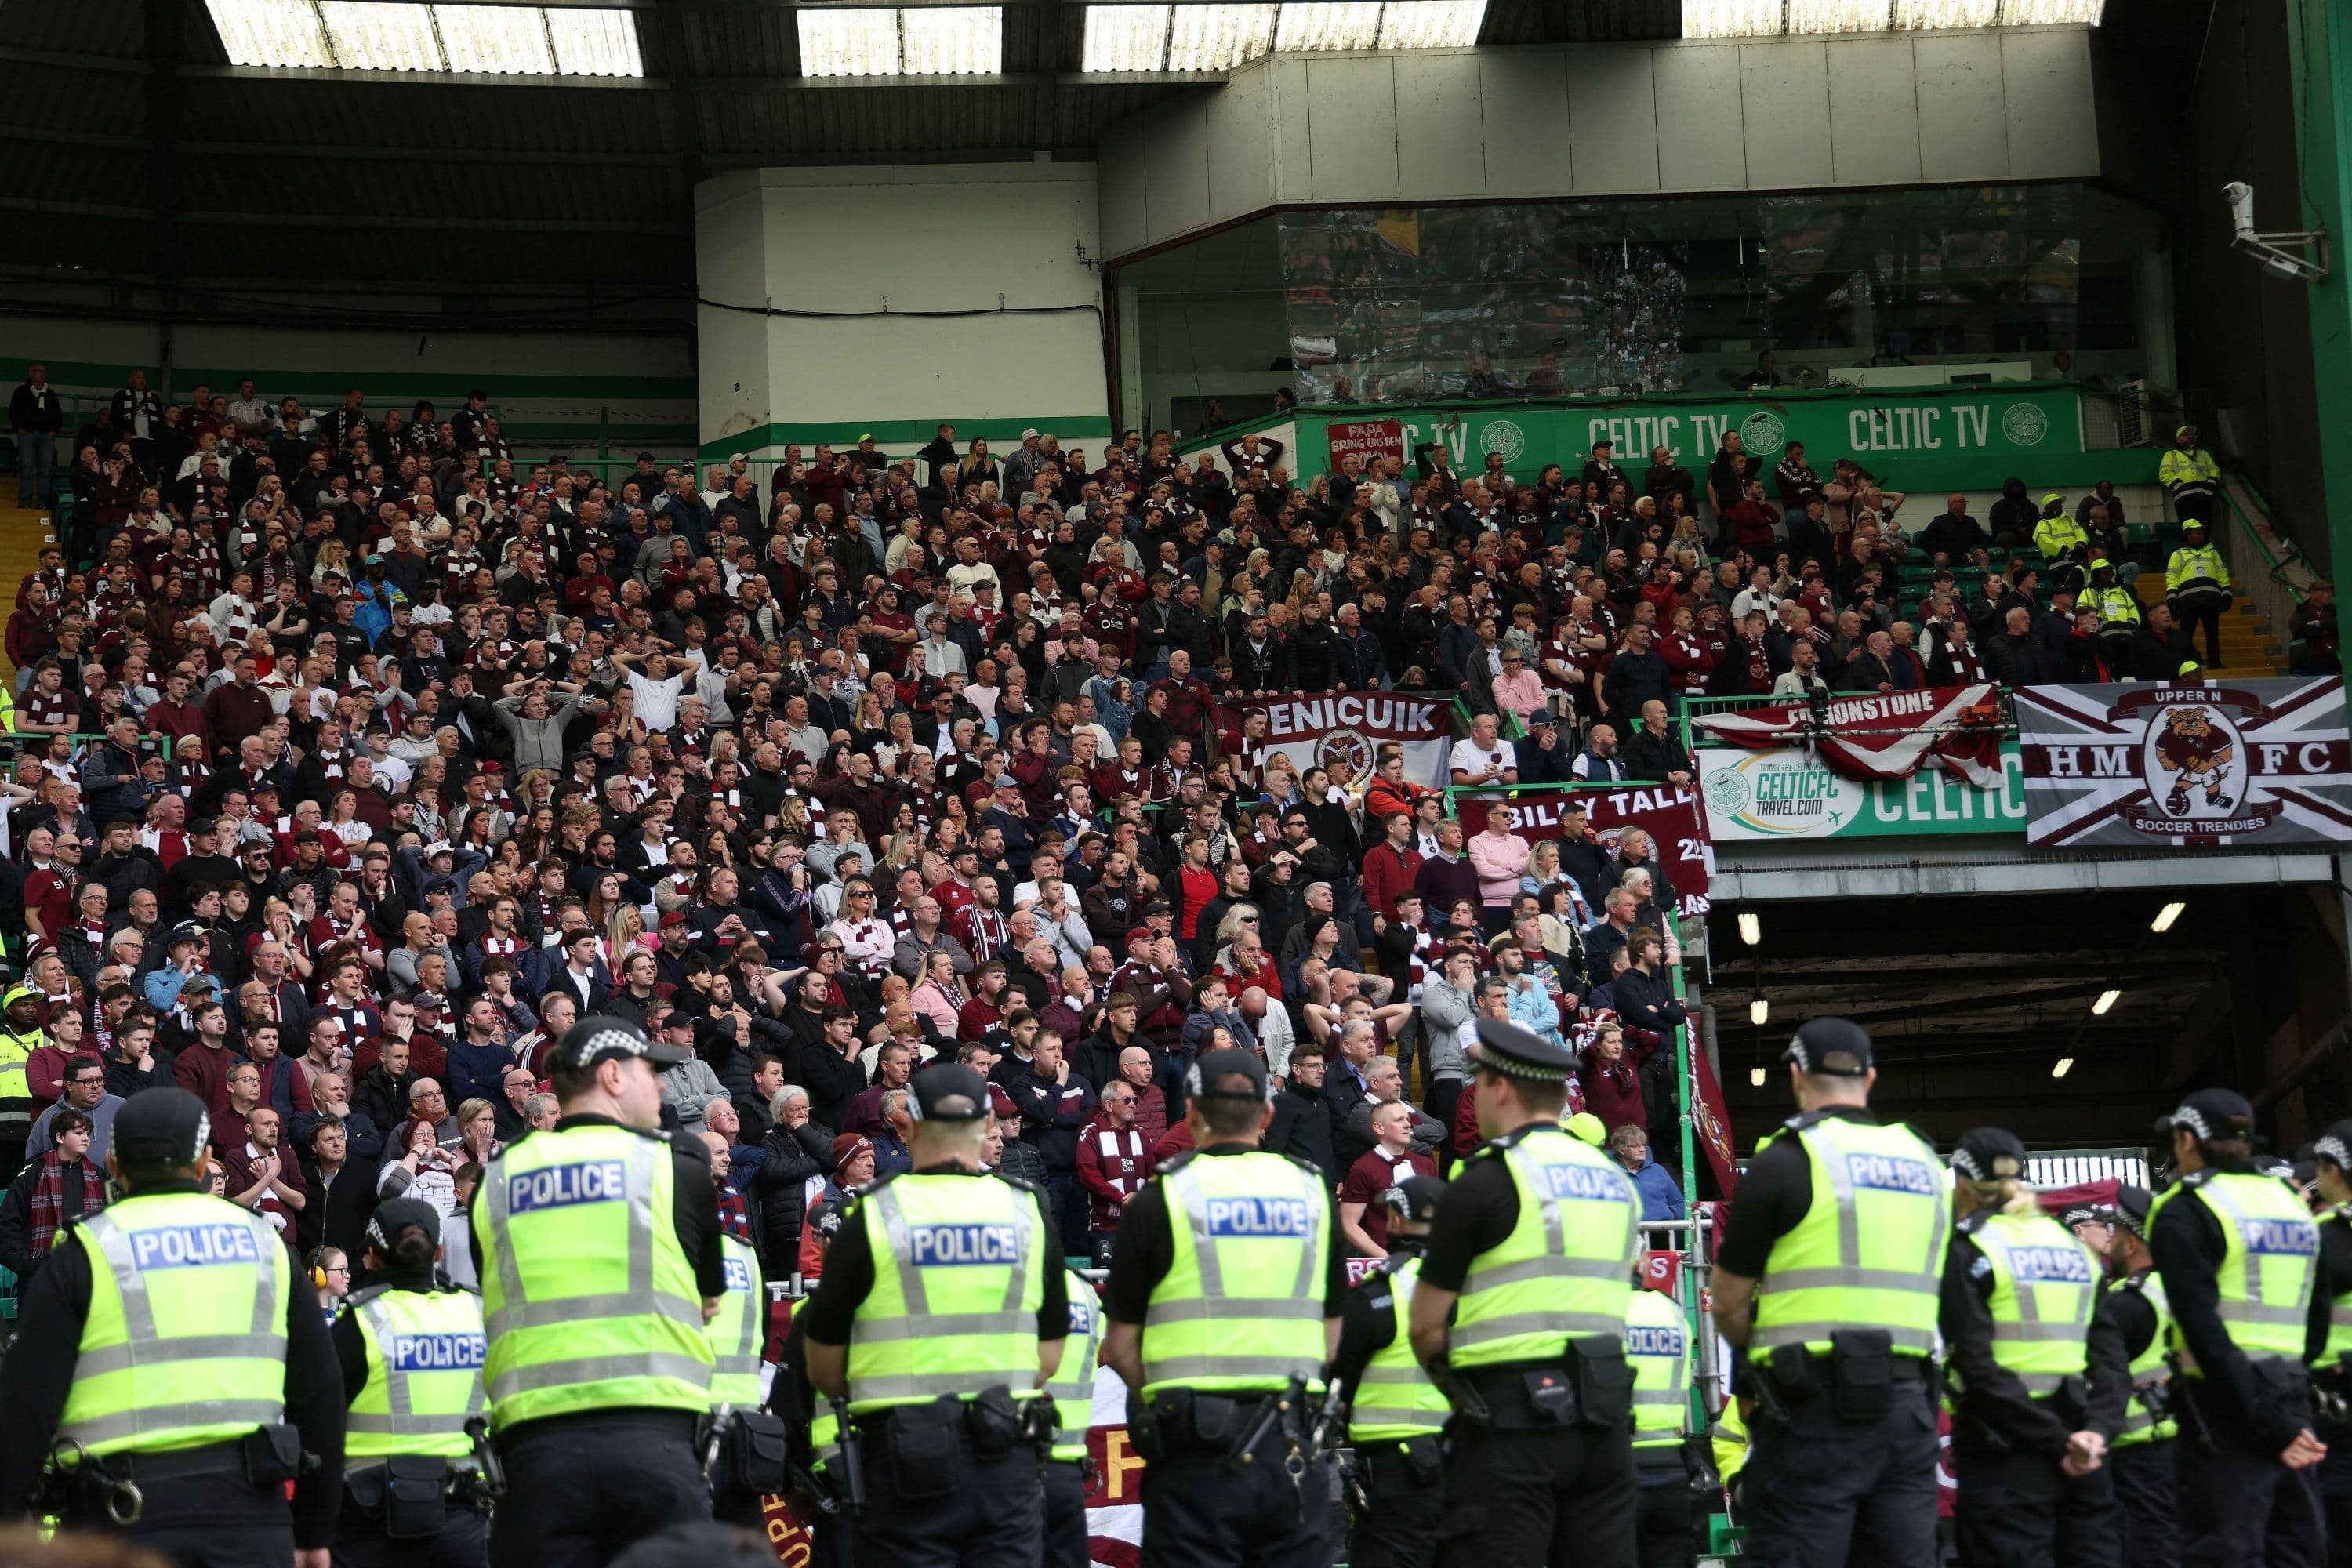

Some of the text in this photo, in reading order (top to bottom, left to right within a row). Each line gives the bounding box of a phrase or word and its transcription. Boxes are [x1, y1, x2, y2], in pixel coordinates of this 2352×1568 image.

[1331, 436, 1402, 453] BRING UNS DEN
[1348, 423, 1385, 438] PAPA
[1589, 416, 1679, 459] CELTIC
[1684, 414, 1728, 458] TV
[1850, 407, 1942, 451] CELTIC
[1952, 405, 1989, 448] TV
[2154, 691, 2222, 702] UPPER N
[1243, 696, 1436, 735] ENICUIK
[1756, 771, 1840, 800] CELTICFC
[1511, 797, 1596, 829] BILY
[1756, 800, 1823, 816] TRAVEL.COM
[2136, 817, 2266, 832] SOCCER TRENDIES
[512, 1163, 624, 1210] POLICE
[1849, 1155, 1933, 1193] POLICE
[1209, 1199, 1308, 1235] POLICE
[136, 1226, 257, 1266] POLICE
[913, 1225, 1018, 1262] POLICE
[2248, 1221, 2318, 1254] POLICE
[2012, 1248, 2091, 1282] POLICE
[397, 1336, 486, 1368] POLICE
[1625, 1327, 1682, 1355] OLICE
